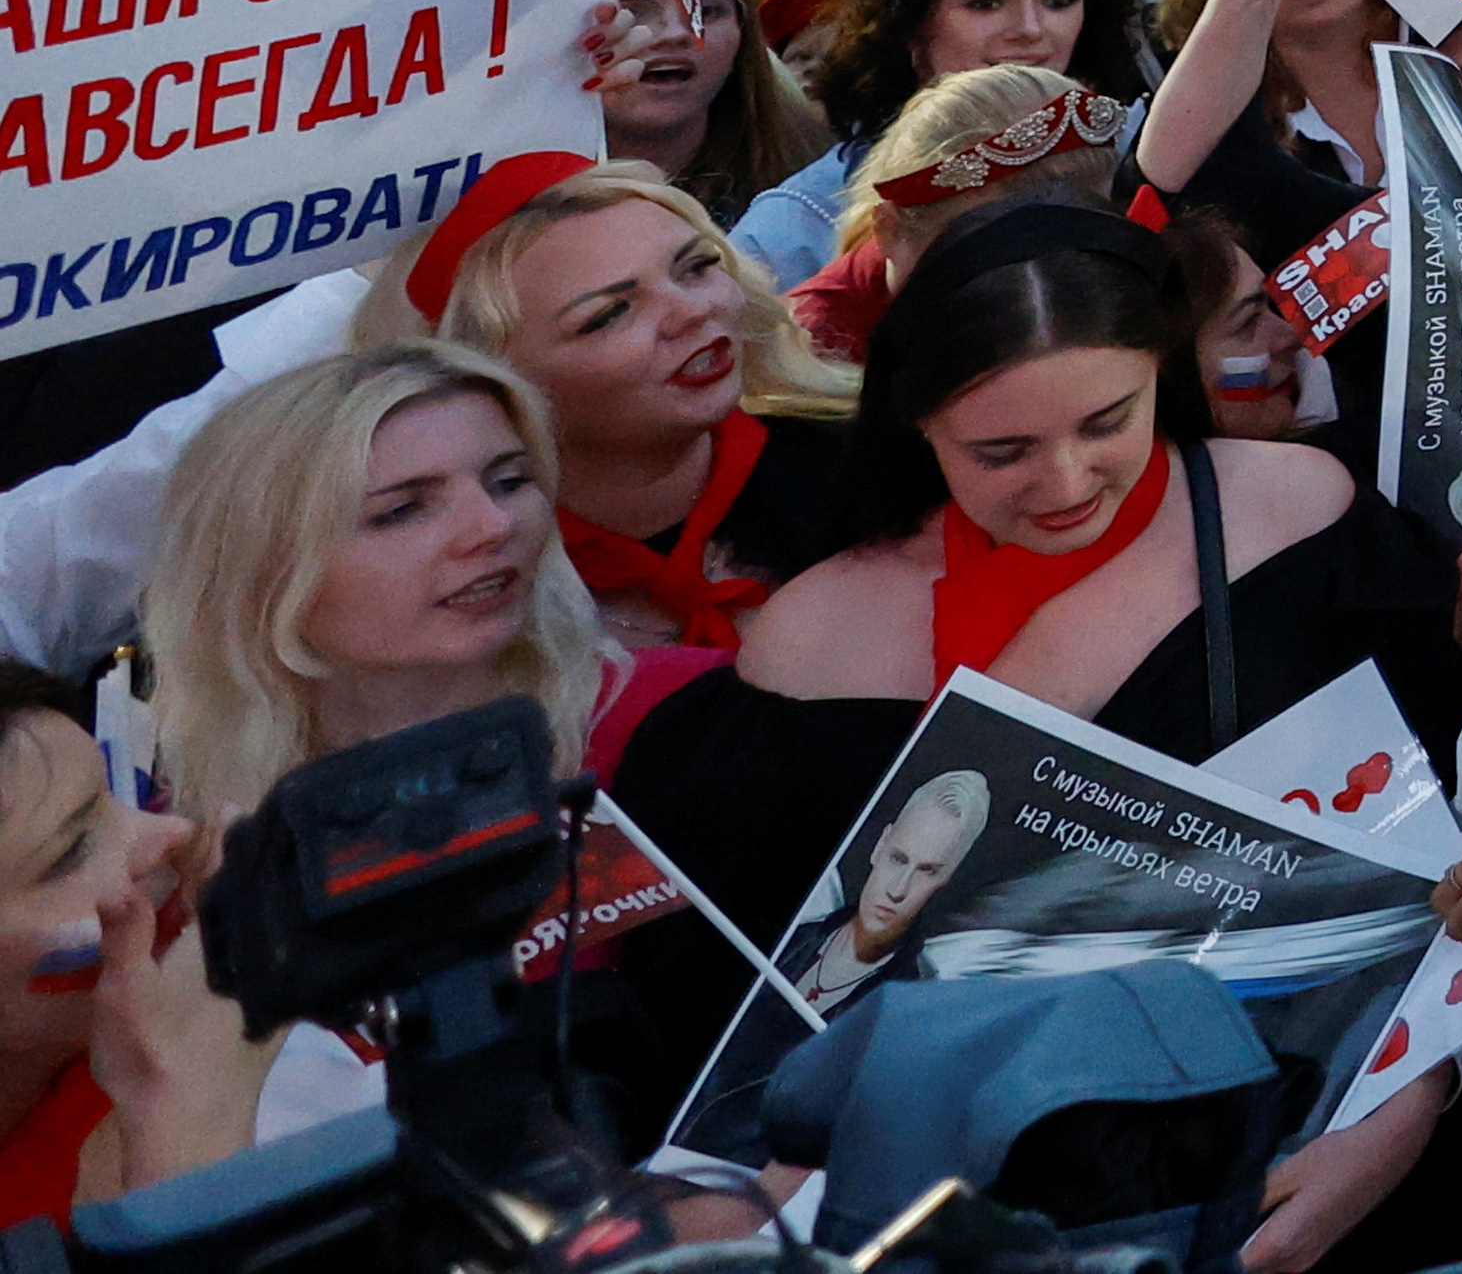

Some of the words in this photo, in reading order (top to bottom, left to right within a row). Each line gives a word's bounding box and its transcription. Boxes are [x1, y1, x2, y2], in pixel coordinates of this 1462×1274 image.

[1422, 185, 1447, 304] SHAMAN
[1424, 314, 1450, 427] музыкой
[1417, 432, 1442, 451] С
[1014, 802, 1052, 834] на
[1050, 817, 1176, 880] крыльях
[1174, 864, 1262, 913] ветра
[1033, 756, 1057, 782] С
[1051, 769, 1165, 828] музыкой
[1168, 811, 1304, 880] SHAMAN
